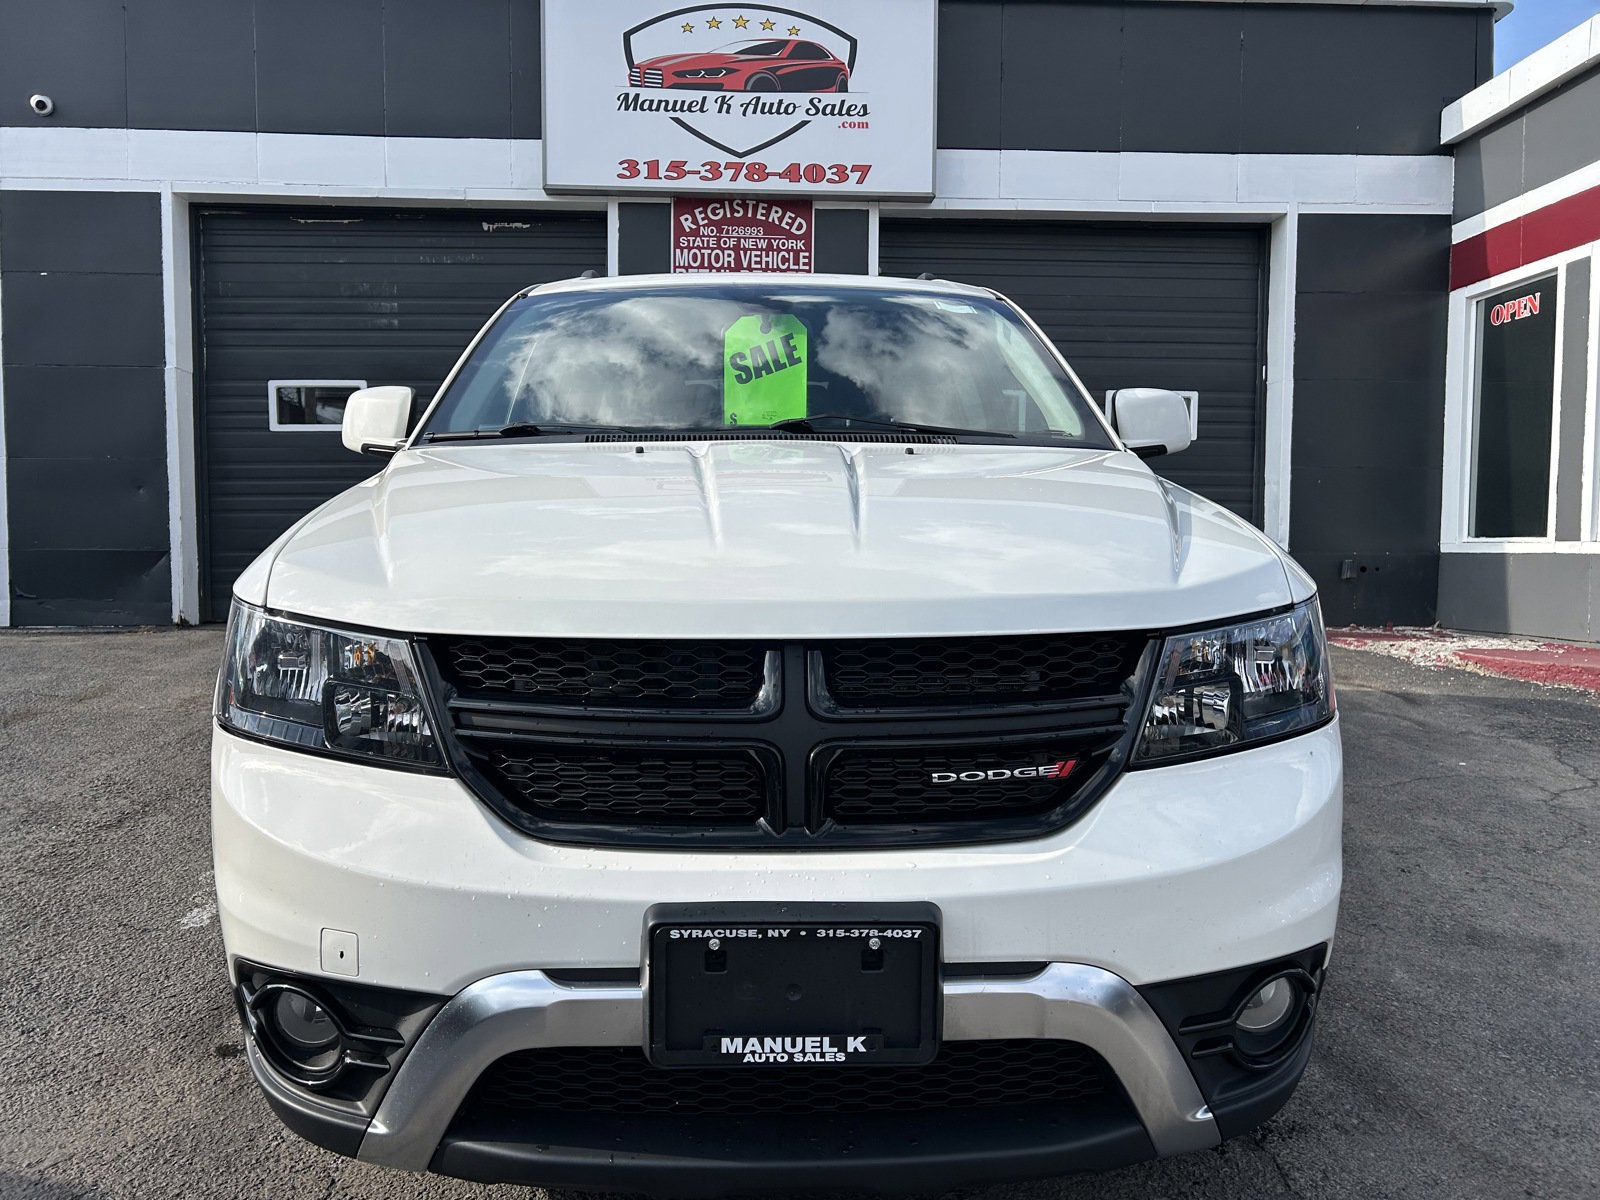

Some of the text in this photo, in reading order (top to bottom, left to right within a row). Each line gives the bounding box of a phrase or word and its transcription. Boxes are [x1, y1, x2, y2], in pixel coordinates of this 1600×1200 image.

[616, 92, 871, 118] Manuel K Auto Sales
[837, 120, 870, 130] .com
[616, 159, 873, 185] 315-378-4037
[679, 199, 808, 236] REGISTERED
[699, 225, 764, 237] NO. 7126993
[679, 237, 806, 250] STATE OF NEW YORK
[675, 249, 810, 270] MOTOR VEHICLE
[1490, 292, 1541, 326] OPEN
[729, 332, 803, 385] SALE
[931, 764, 1060, 783] DODGE
[669, 929, 922, 939] SYRACUSE, NY 315-378-4037
[721, 1036, 867, 1054] MANUEL K
[743, 1052, 846, 1063] AUTO SALES
